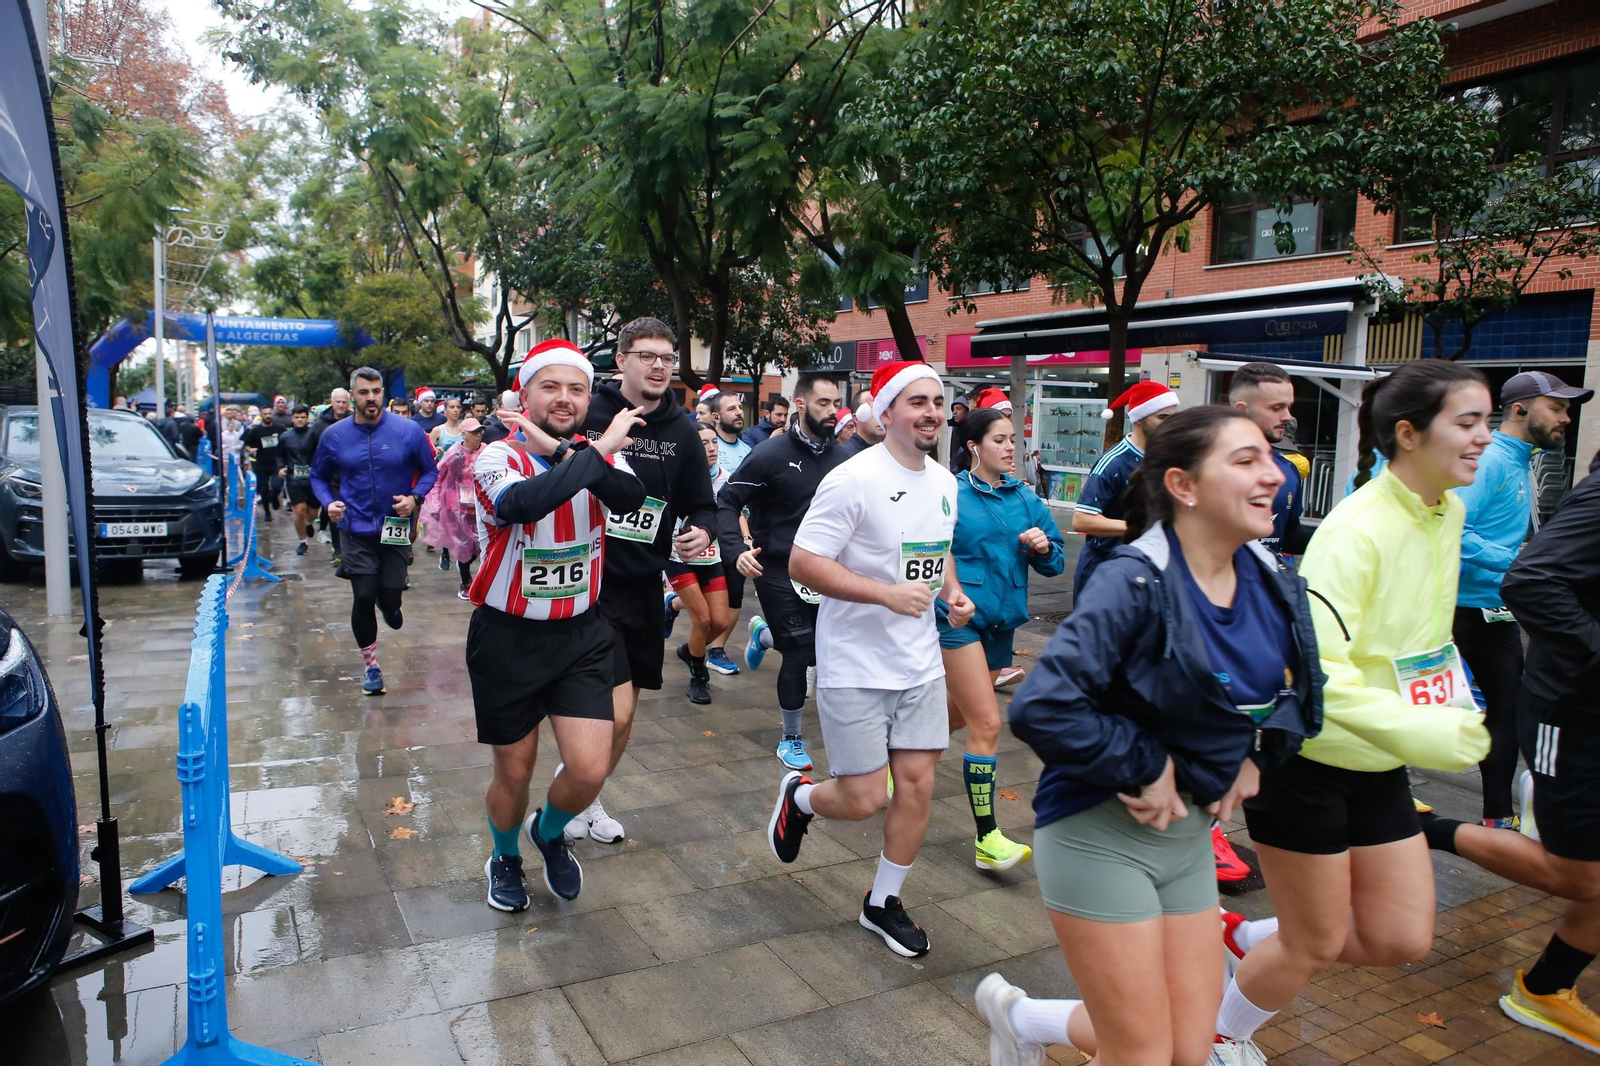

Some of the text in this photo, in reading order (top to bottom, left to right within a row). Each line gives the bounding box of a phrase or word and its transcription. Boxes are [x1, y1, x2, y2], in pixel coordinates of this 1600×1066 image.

[226, 331, 299, 342] ALGECIRAS
[111, 525, 139, 535] 0548
[385, 526, 407, 538] 131
[529, 561, 584, 586] 216
[906, 557, 944, 581] 684
[1409, 669, 1454, 706] 631
